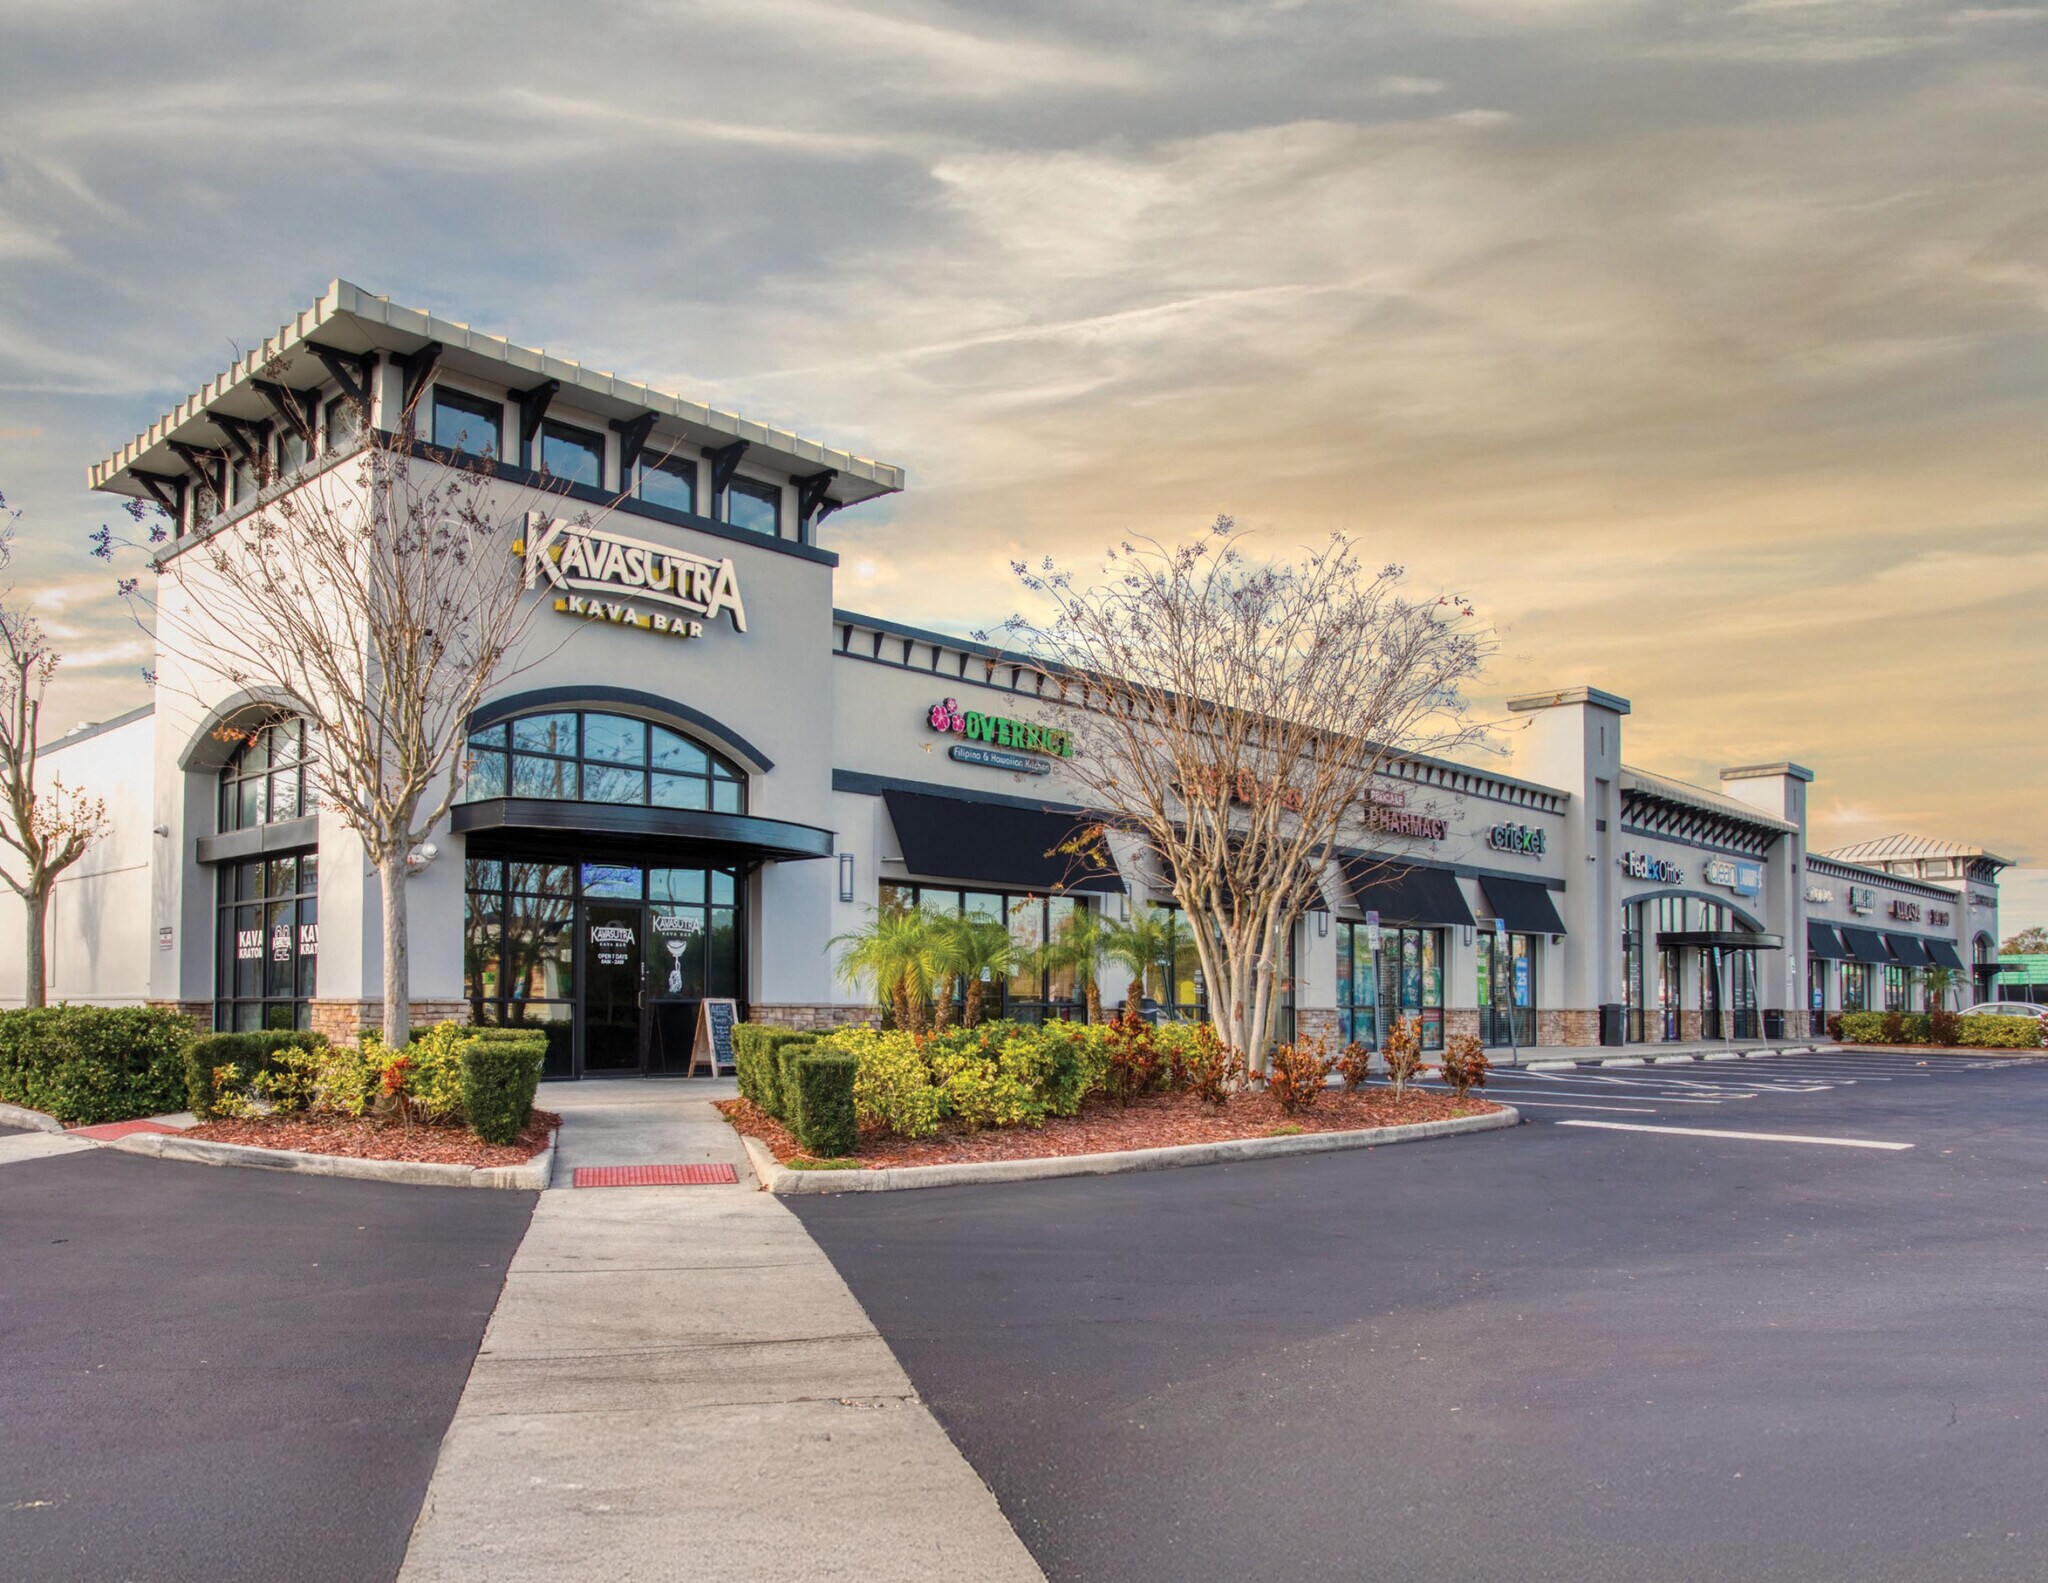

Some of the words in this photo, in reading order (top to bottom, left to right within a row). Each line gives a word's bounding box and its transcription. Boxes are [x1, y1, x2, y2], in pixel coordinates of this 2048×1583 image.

[525, 511, 747, 632] KAVASUTRA
[568, 595, 639, 625] KAVA
[653, 613, 703, 638] BAR
[954, 747, 981, 760] Filipino
[991, 753, 1023, 767] Hawaiian
[1369, 806, 1449, 840] PHARMACY
[1491, 821, 1546, 854] cricket
[1629, 851, 1660, 880] FedEx
[239, 930, 263, 947] KAVA
[591, 926, 635, 945] KAVASUTRA
[652, 915, 702, 935] KAVASUTRA
